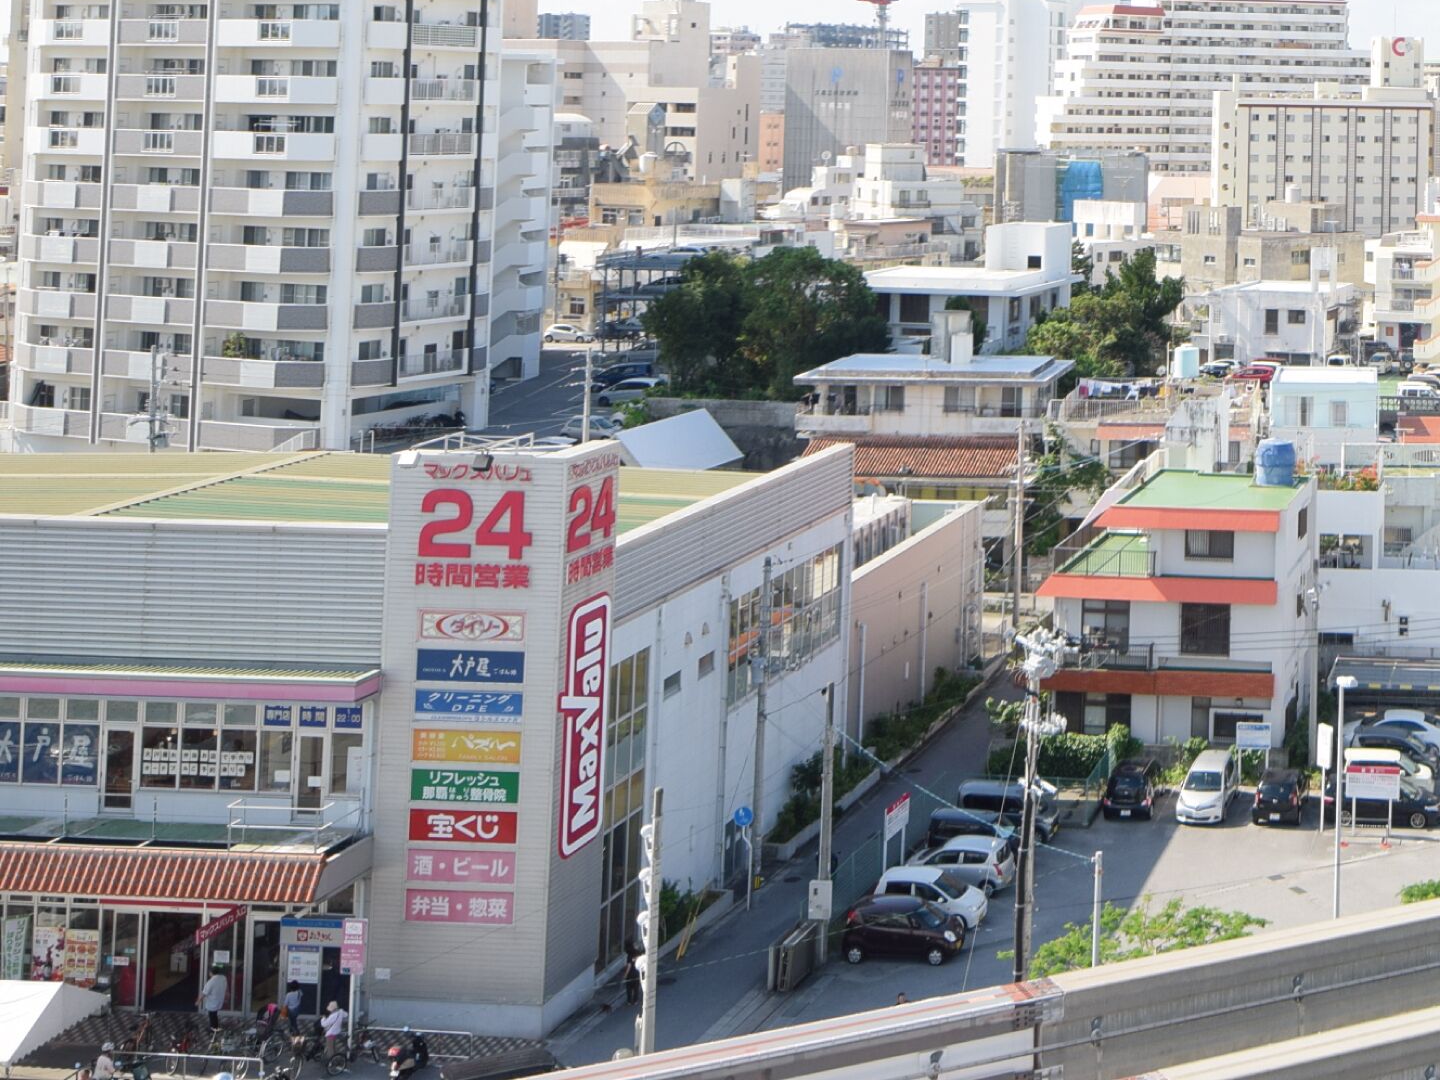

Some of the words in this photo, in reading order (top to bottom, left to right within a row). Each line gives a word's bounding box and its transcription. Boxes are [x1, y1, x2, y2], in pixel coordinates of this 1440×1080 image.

[418, 488, 532, 560] 24
[567, 475, 616, 553] 24
[415, 563, 530, 589] 時間営業
[566, 544, 614, 586] 時間営業
[450, 619, 500, 634] ダイソー
[449, 653, 491, 678] 大戸屋
[428, 692, 512, 705] クリーニング
[451, 704, 488, 713] DPE
[561, 617, 603, 833] MaxValu
[430, 771, 500, 786] リフレッシュ
[427, 813, 499, 839] 宝くじ
[413, 855, 509, 877] 酒・ビール
[411, 896, 508, 918] 弁当・惣菜
